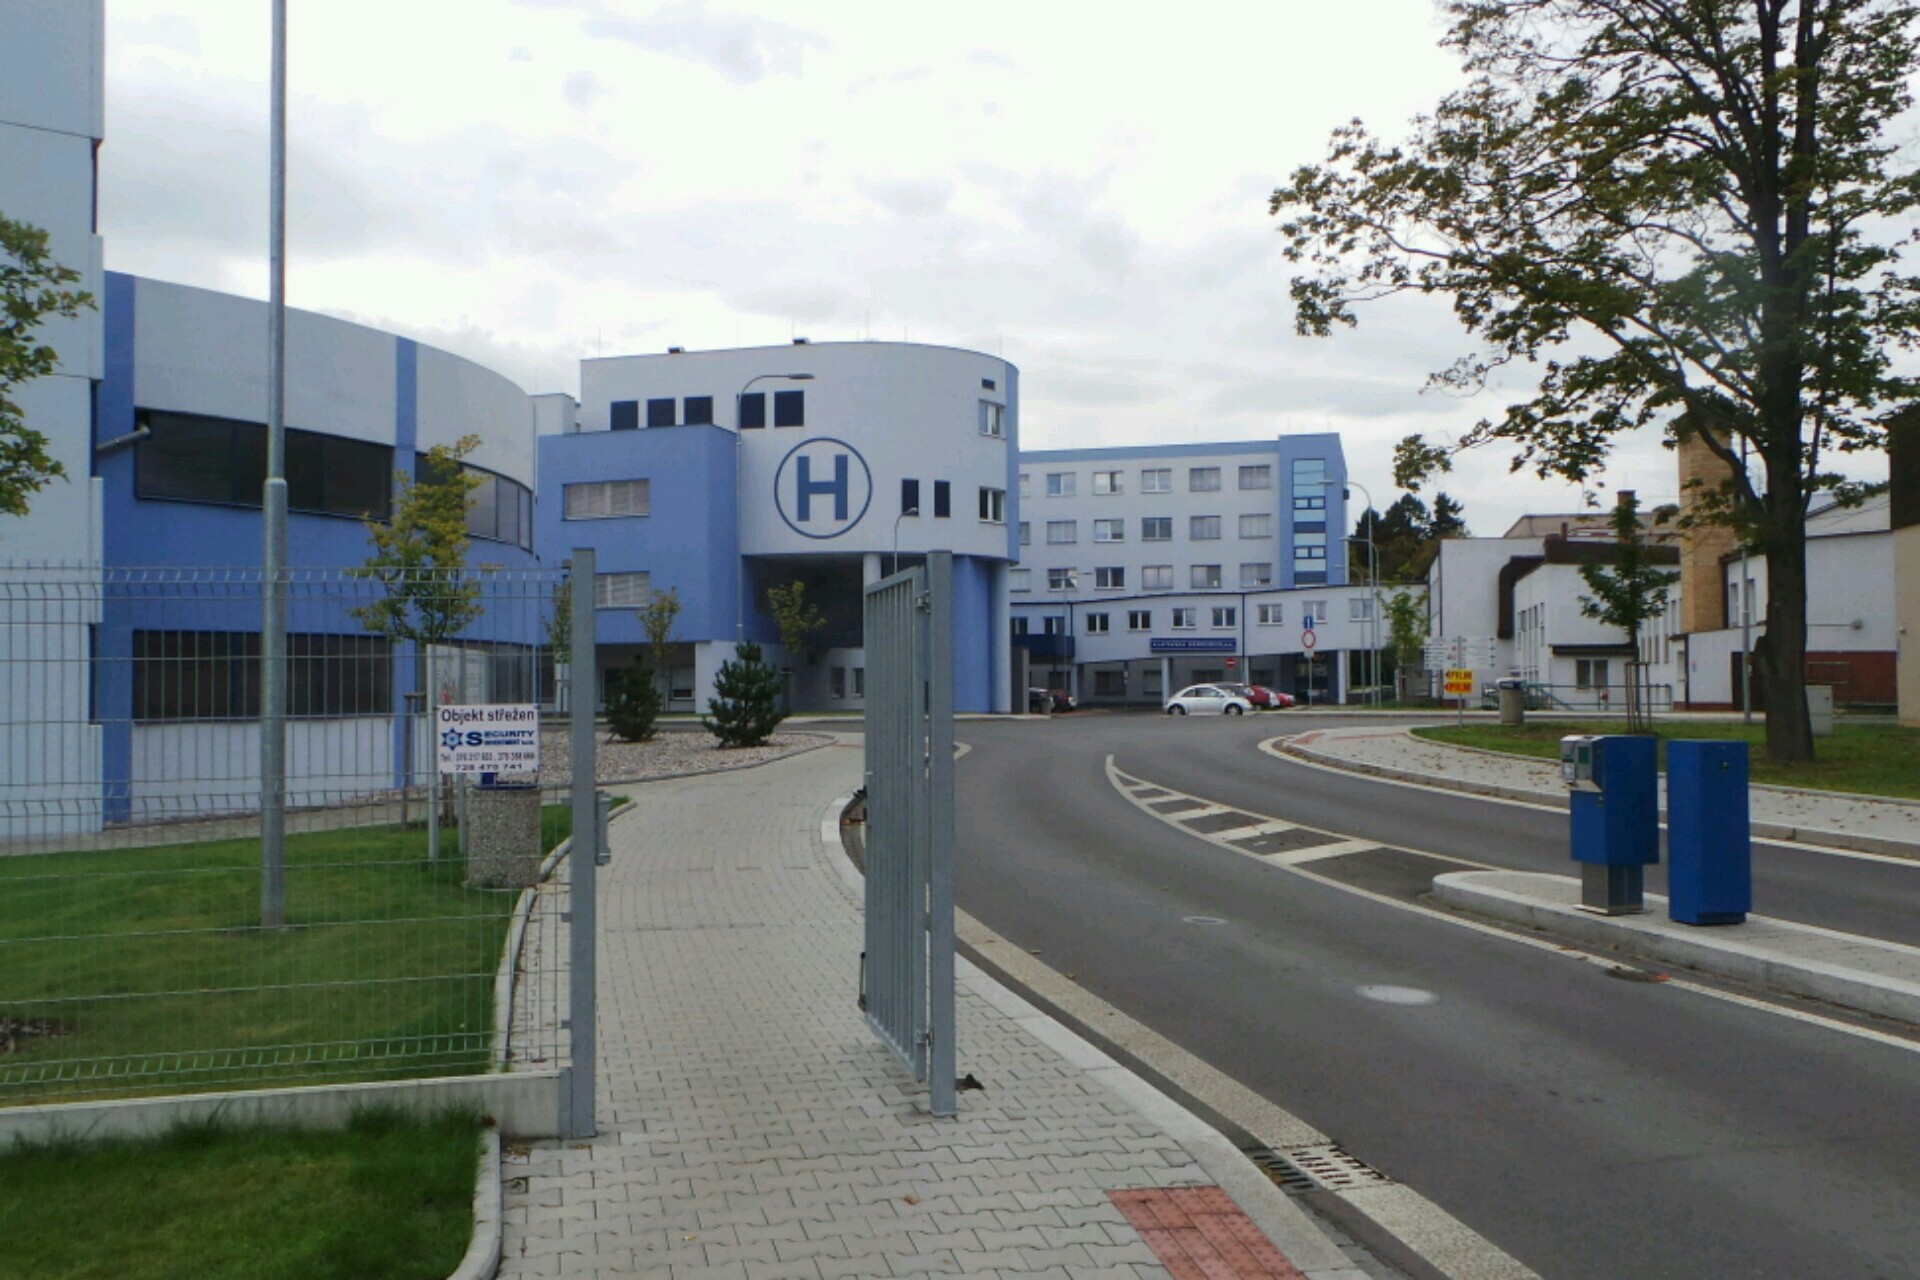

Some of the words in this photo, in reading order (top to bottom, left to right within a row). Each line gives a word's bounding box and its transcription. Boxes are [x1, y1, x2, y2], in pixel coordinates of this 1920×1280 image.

[797, 454, 848, 521] H
[442, 709, 484, 725] Objekt
[487, 707, 534, 721] střežen
[466, 730, 534, 747] SECURITY
